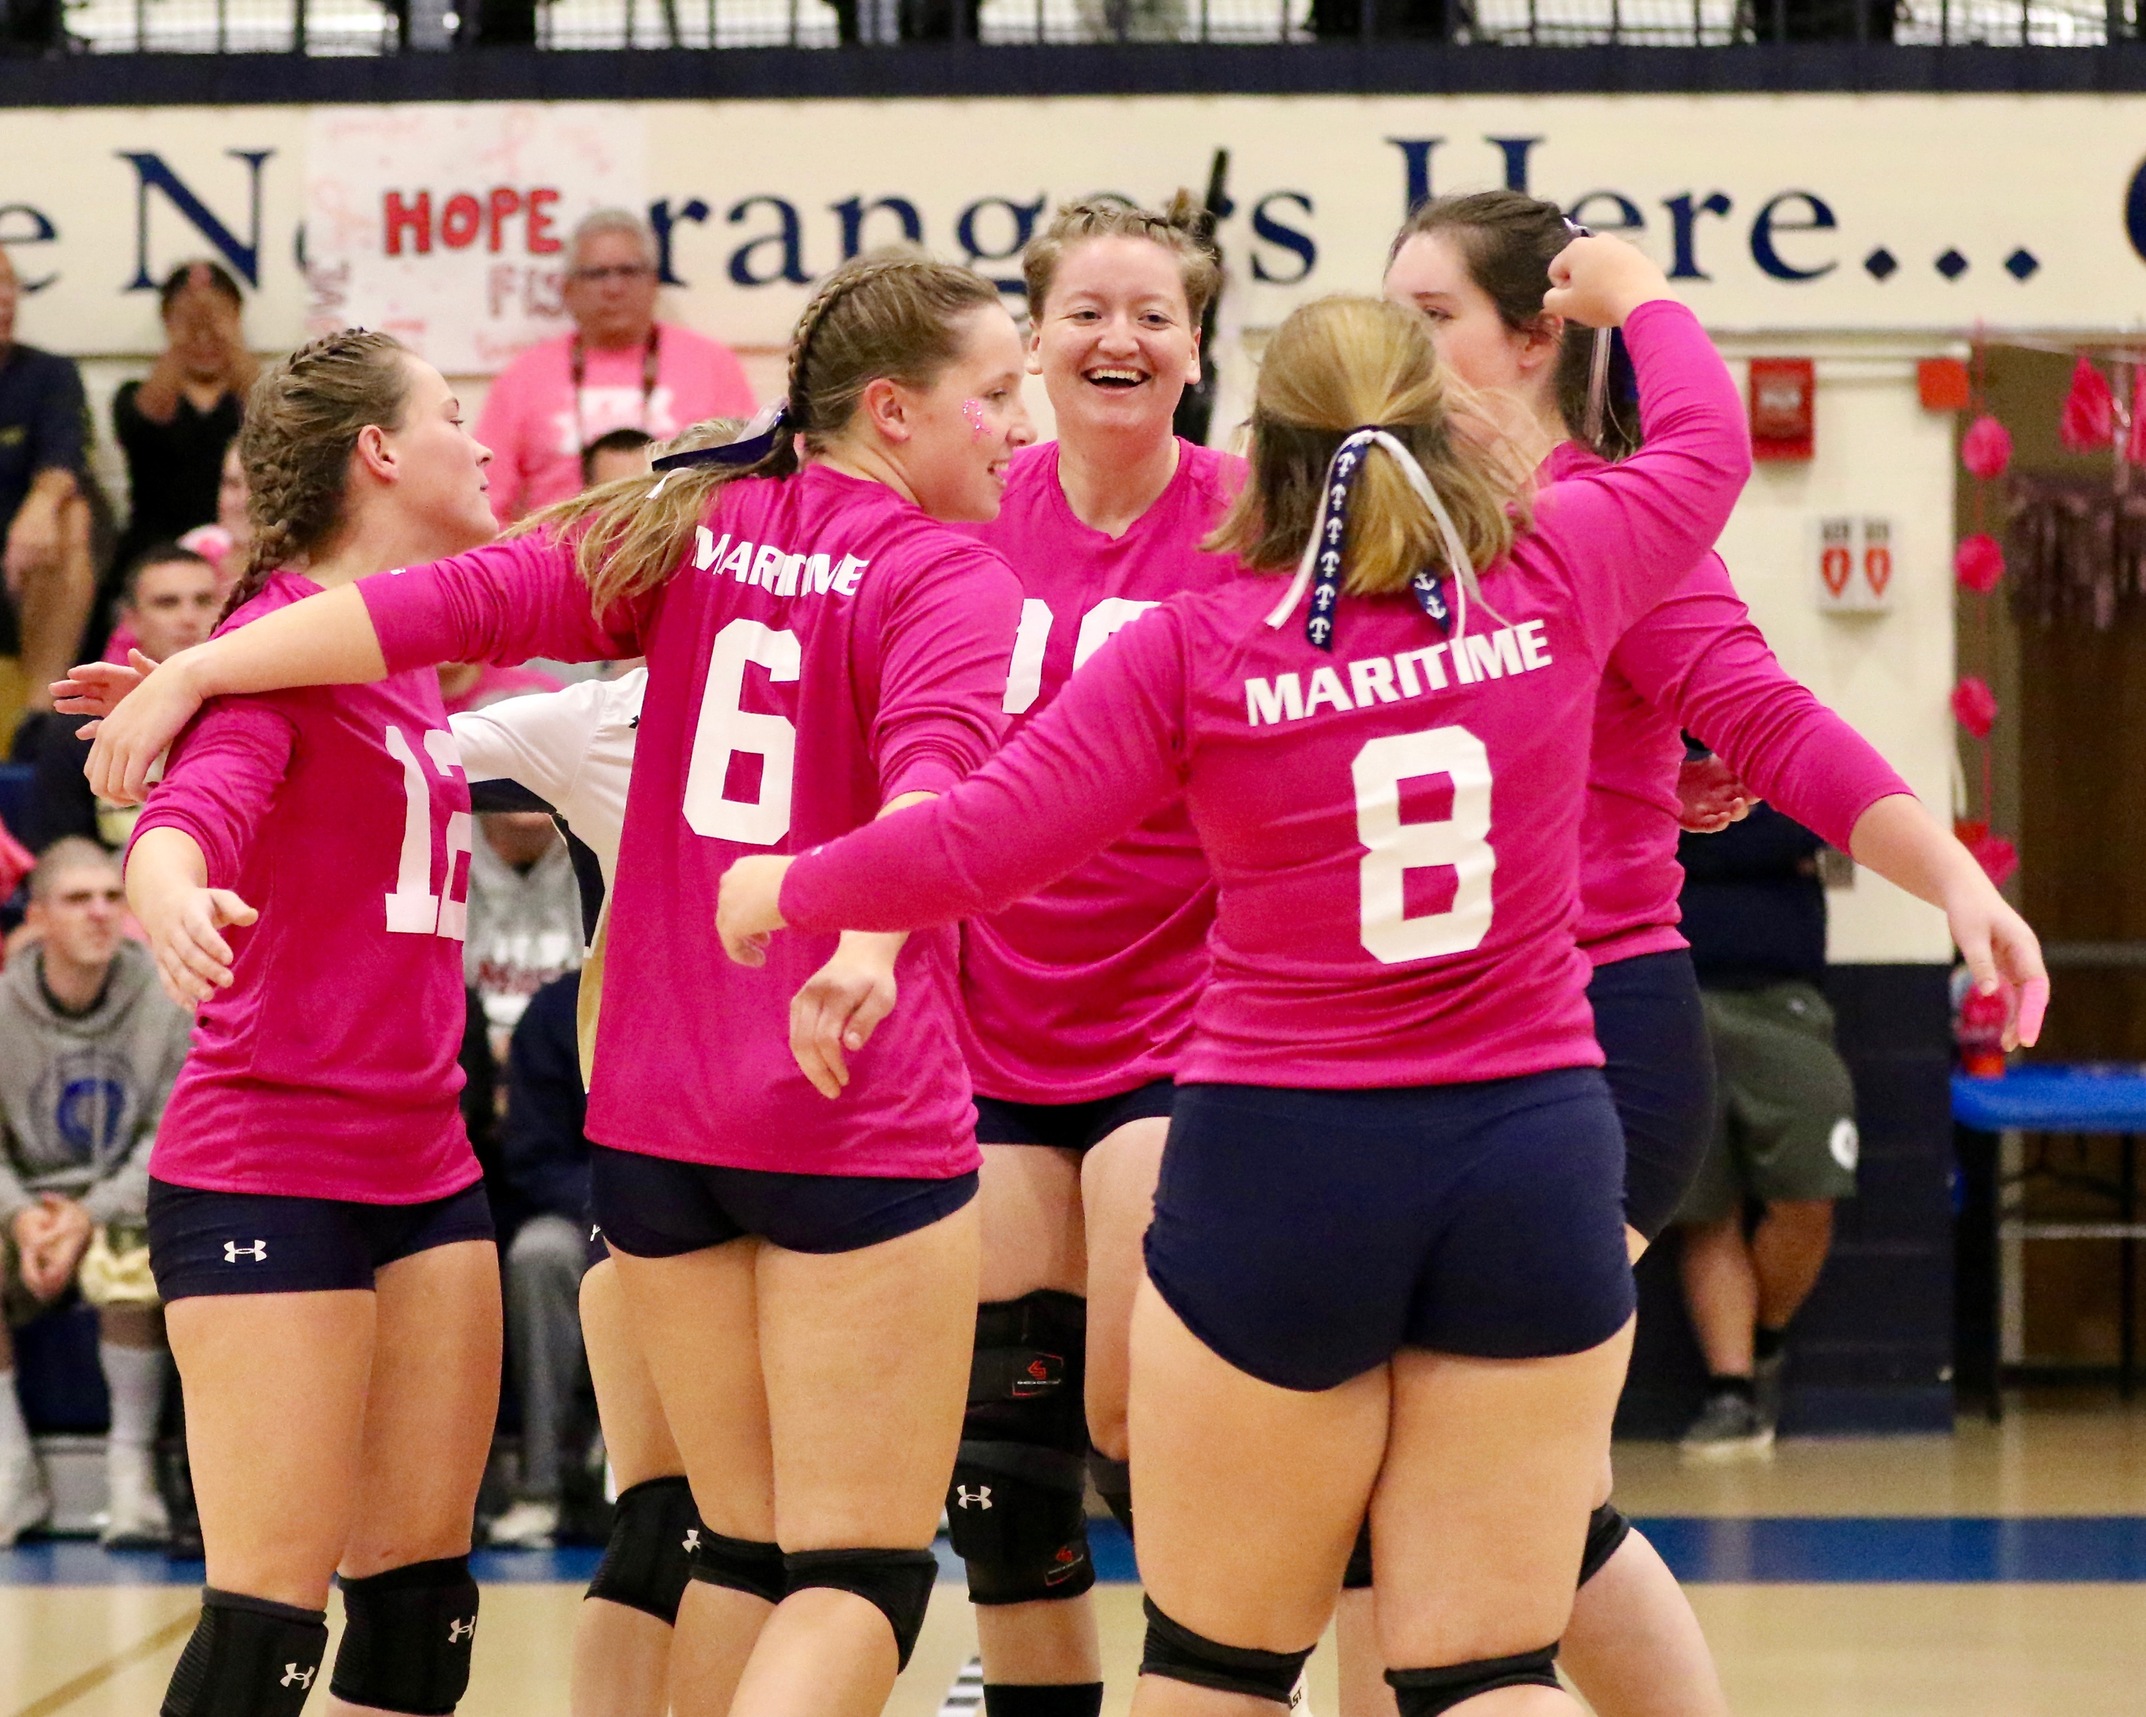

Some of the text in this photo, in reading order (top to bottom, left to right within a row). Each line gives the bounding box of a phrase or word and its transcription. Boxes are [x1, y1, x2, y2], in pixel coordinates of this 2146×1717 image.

[111, 147, 308, 291] N
[383, 187, 564, 256] HOPE
[682, 618, 802, 846] 6
[1244, 618, 1553, 727] MARITIME
[384, 725, 473, 941] 12
[1351, 724, 1496, 965] 8
